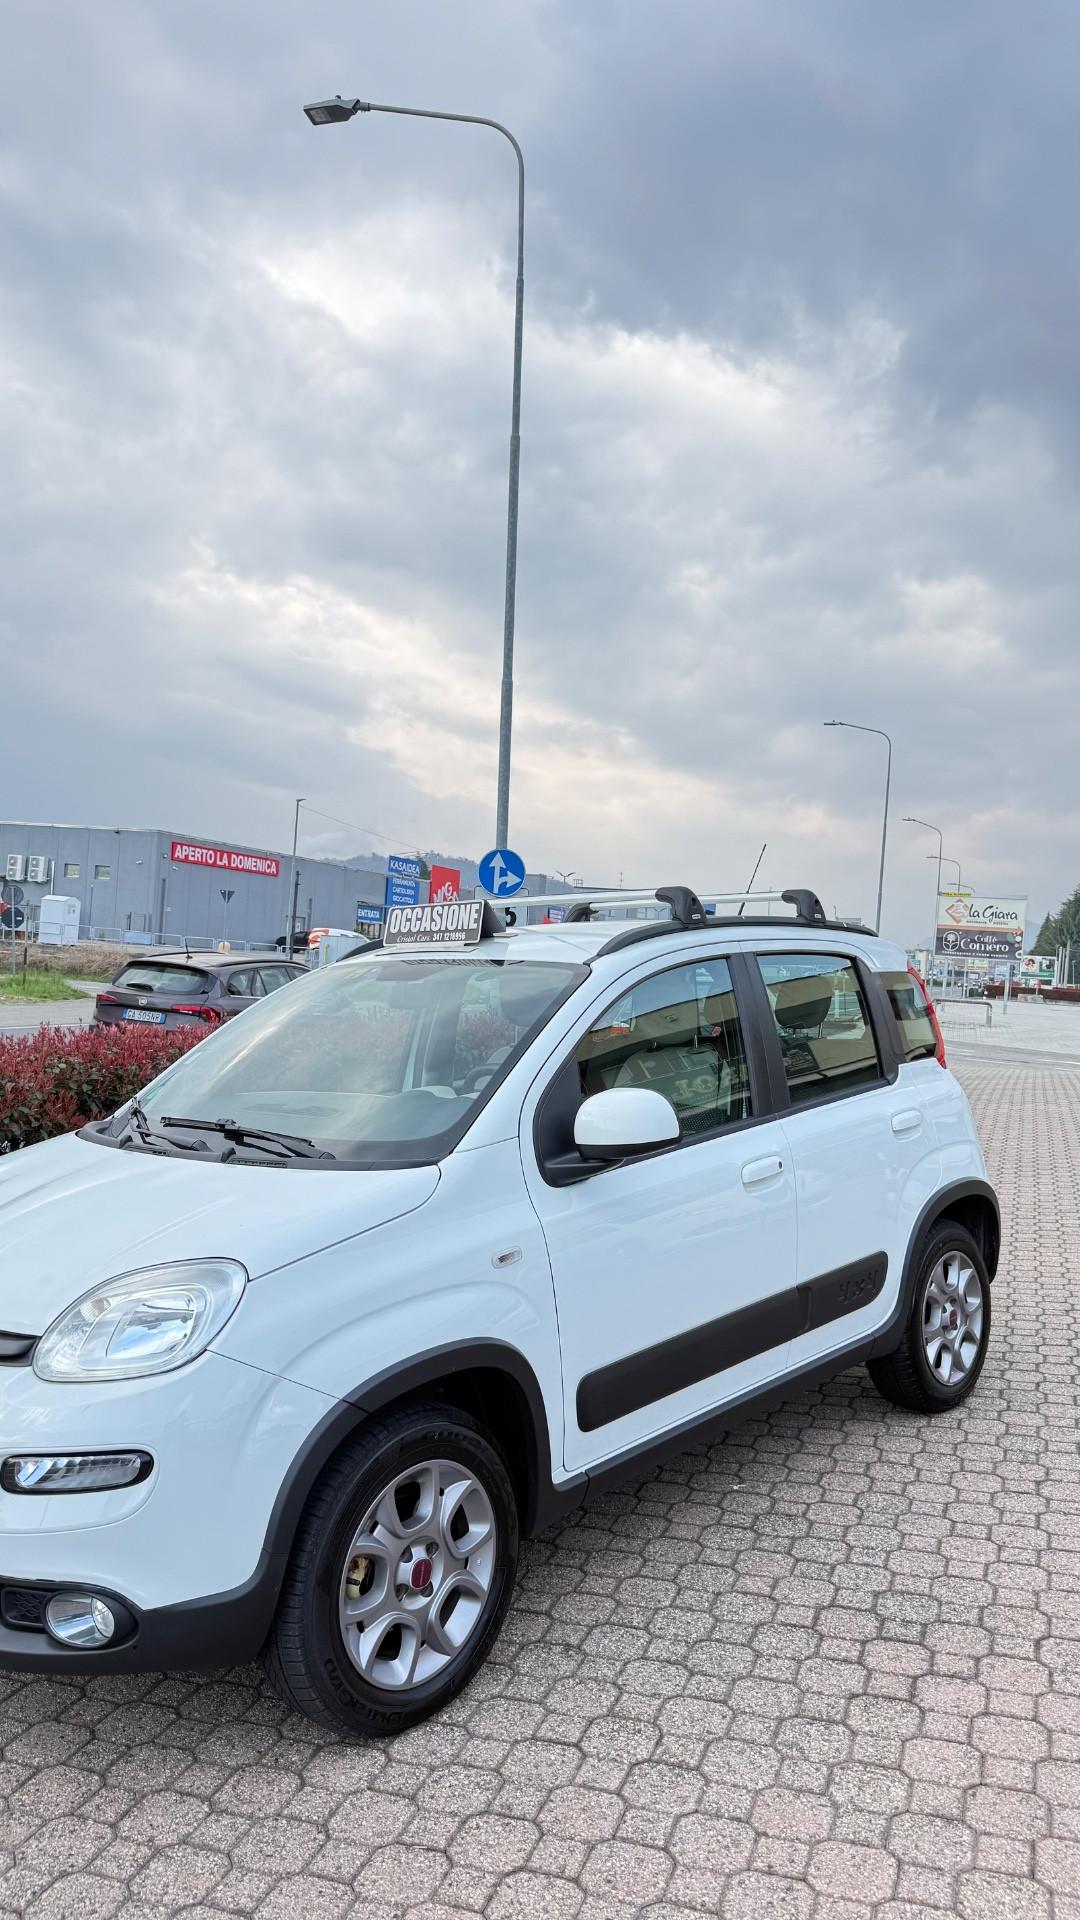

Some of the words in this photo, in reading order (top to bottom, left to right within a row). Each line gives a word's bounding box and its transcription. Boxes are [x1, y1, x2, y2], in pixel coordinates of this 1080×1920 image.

[175, 845, 214, 864] APERTO
[216, 852, 228, 867] LA
[231, 854, 277, 874] DOMENICA
[390, 860, 420, 875] KASAIDEA
[357, 908, 380, 919] ENTRATA
[389, 903, 480, 934] OCCASIONE
[982, 905, 1018, 923] Giara
[433, 932, 443, 941] 347
[960, 937, 1009, 952] Comero
